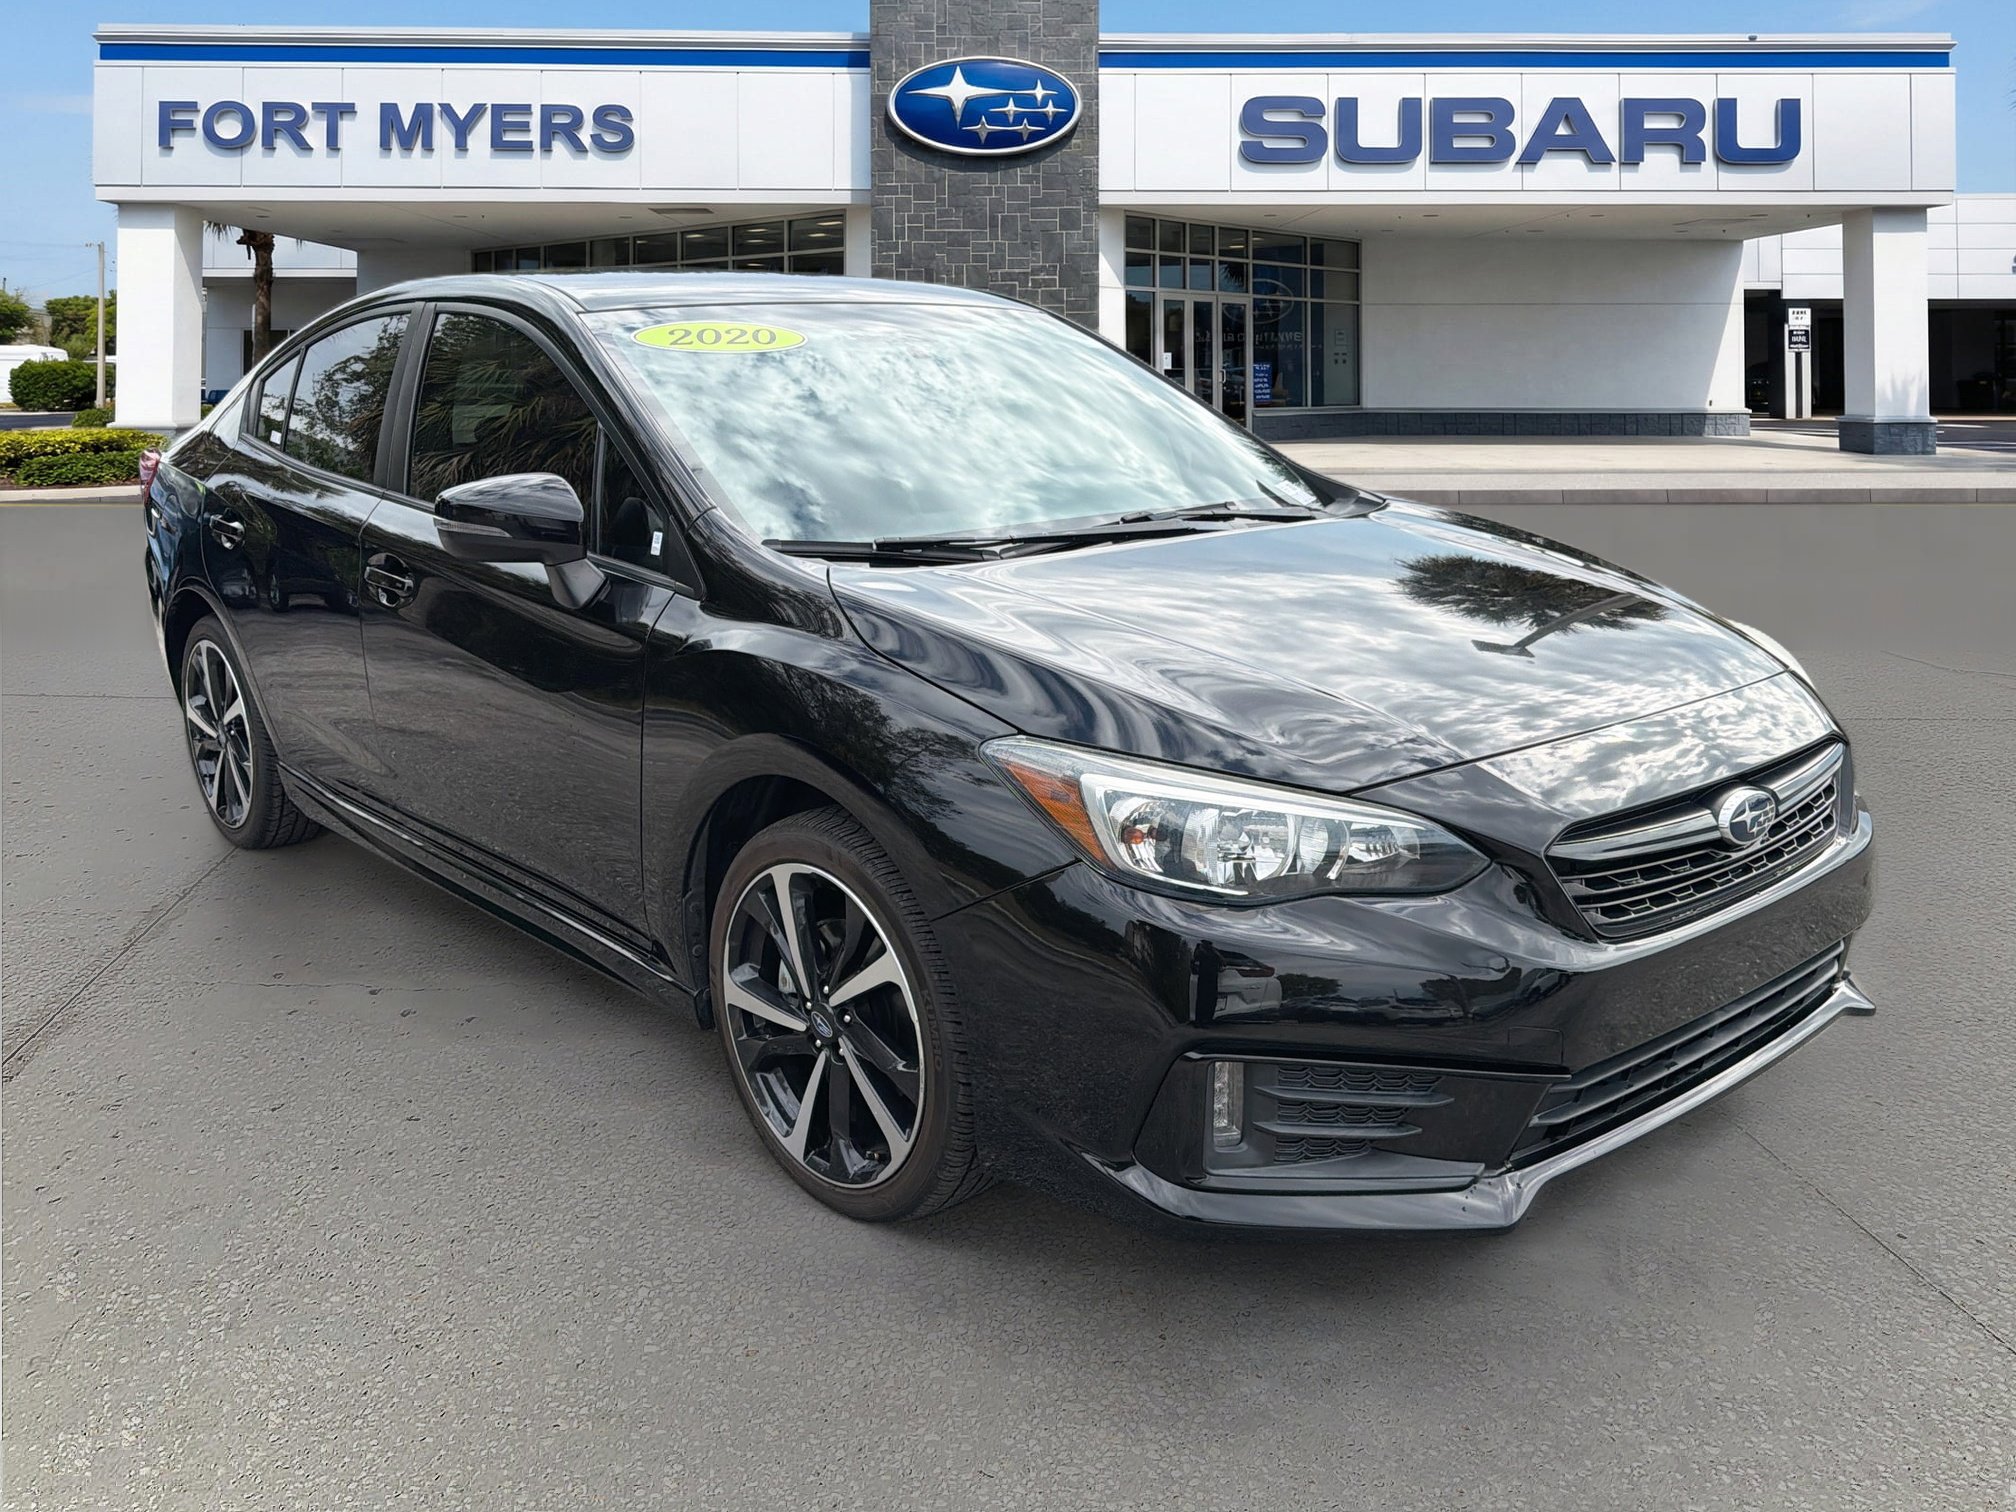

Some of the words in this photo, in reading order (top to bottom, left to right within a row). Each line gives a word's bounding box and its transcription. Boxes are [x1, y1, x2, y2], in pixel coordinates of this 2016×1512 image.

[158, 100, 357, 150] FORT
[379, 102, 635, 153] MYERS
[1239, 96, 1801, 165] SUBARU
[668, 328, 777, 346] 2020
